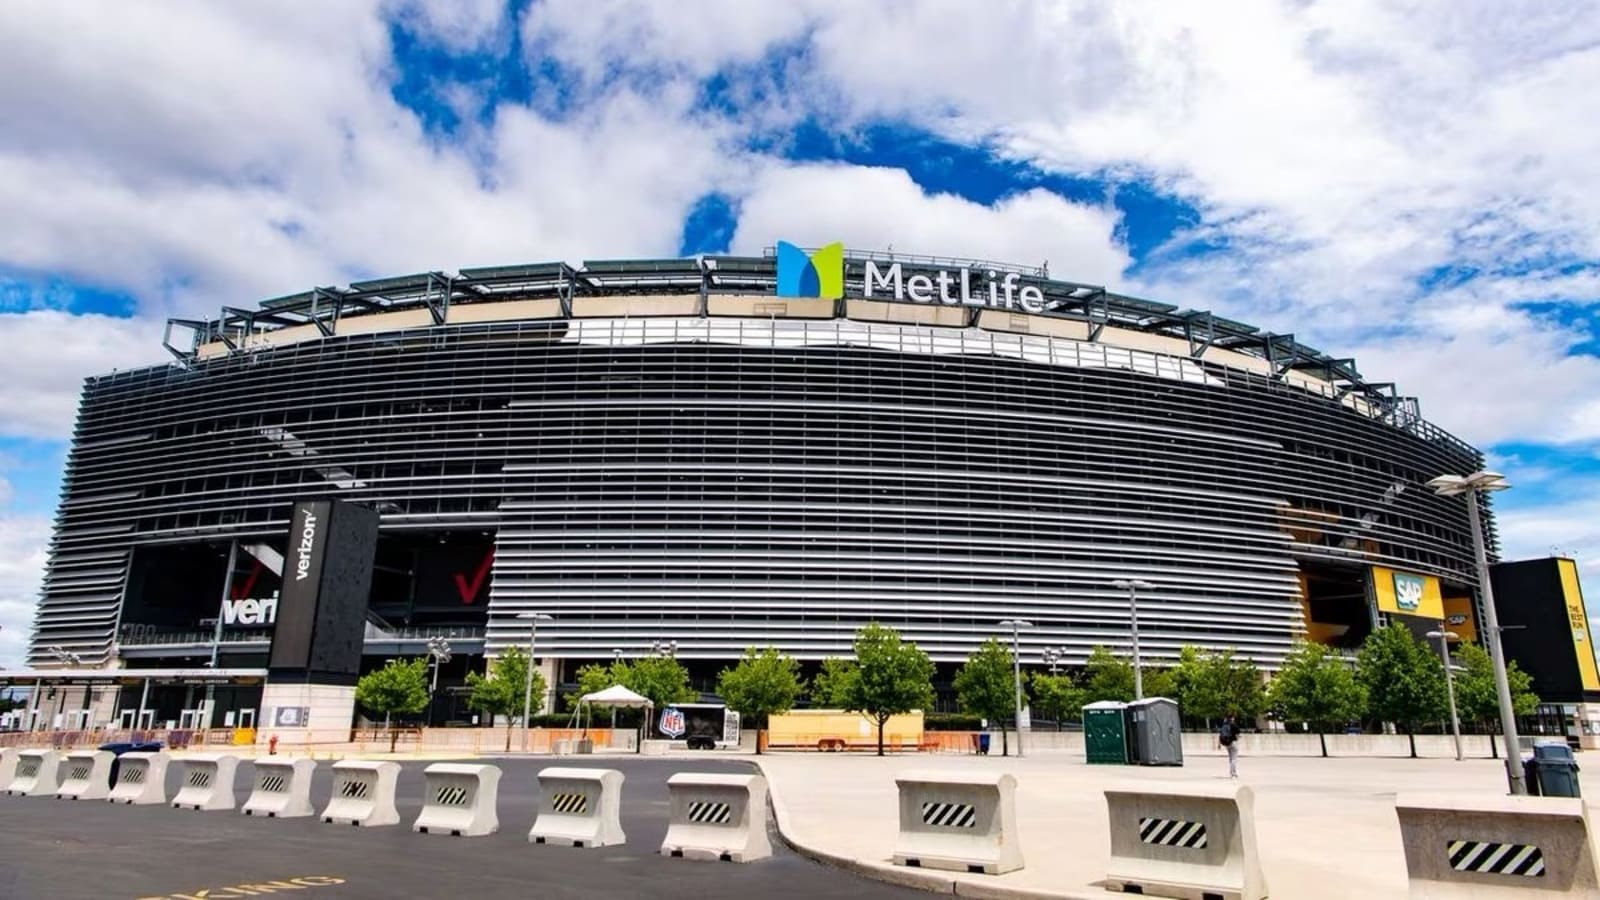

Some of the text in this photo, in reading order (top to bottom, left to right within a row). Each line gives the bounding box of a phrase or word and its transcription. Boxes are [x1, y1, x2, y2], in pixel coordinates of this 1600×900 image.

[864, 261, 1044, 312] MetLife
[295, 513, 317, 581] verizon
[1397, 578, 1422, 605] SAP
[664, 713, 683, 730] NFL
[137, 875, 346, 900] KING
